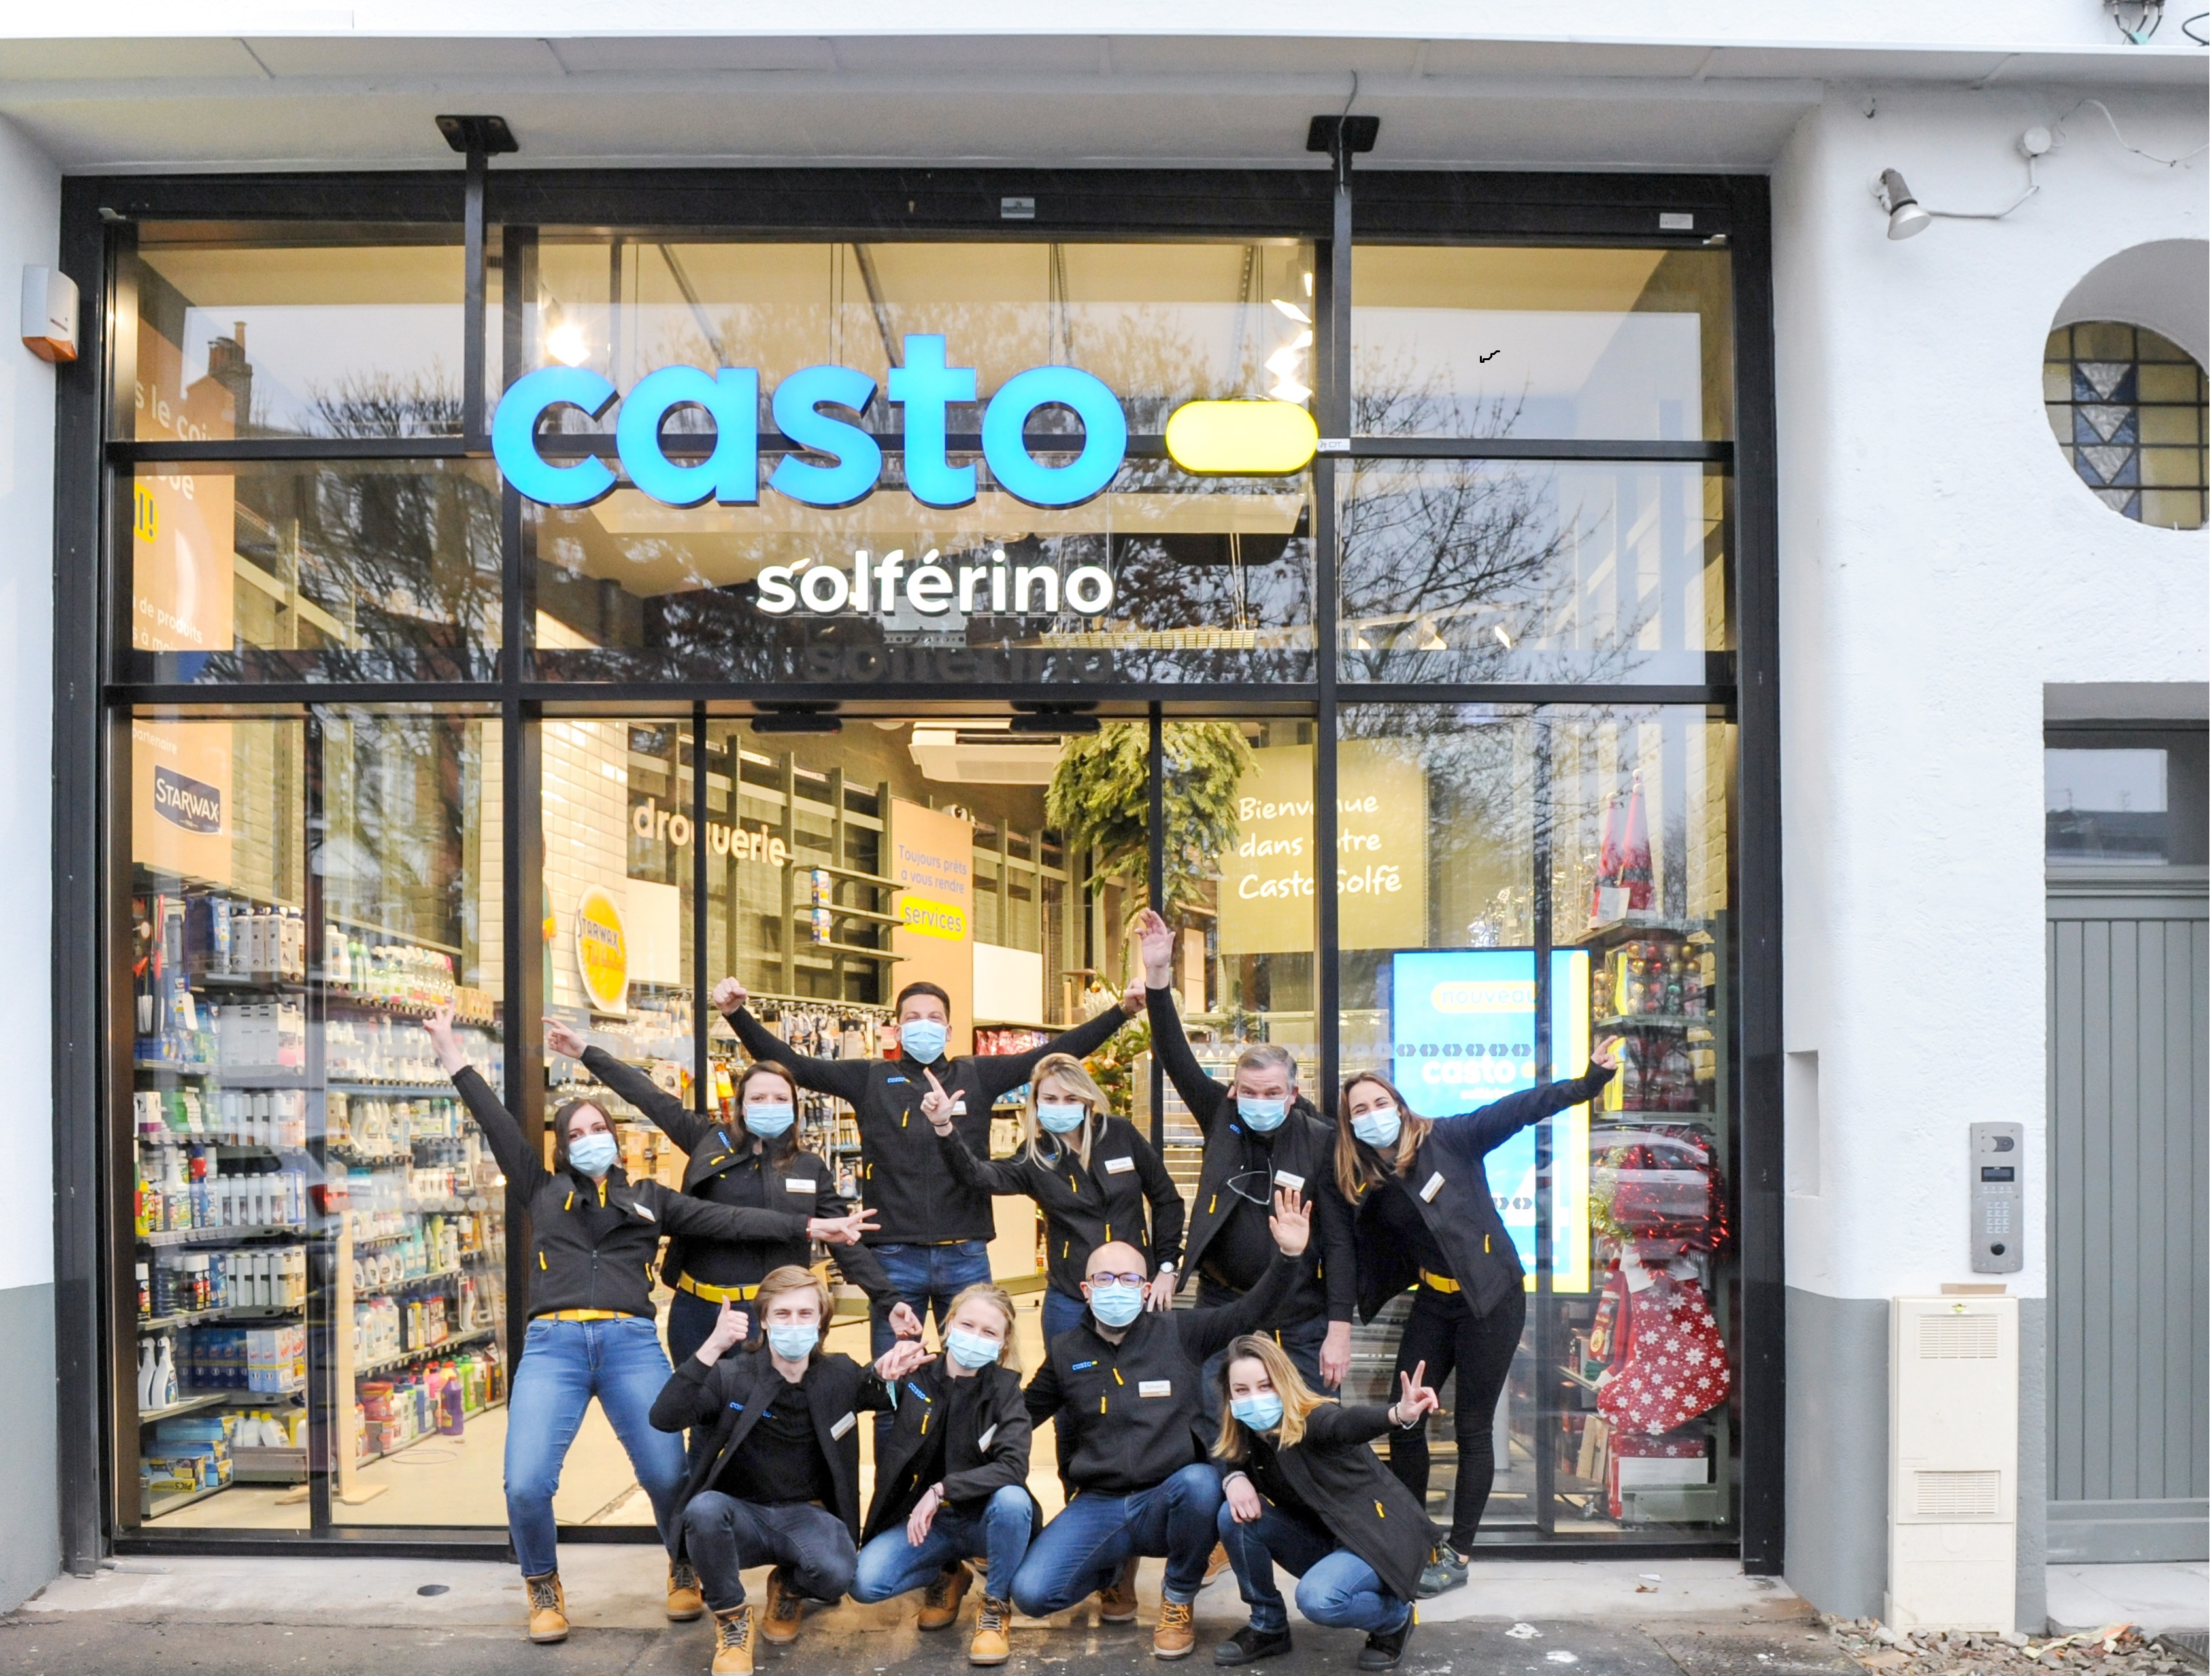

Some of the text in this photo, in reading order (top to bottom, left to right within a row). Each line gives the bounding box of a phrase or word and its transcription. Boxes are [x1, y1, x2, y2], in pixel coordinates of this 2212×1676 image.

[152, 384, 171, 428] le
[492, 334, 1128, 508] casto
[756, 548, 1114, 616] solférino
[139, 597, 203, 645] de produits
[133, 726, 177, 754] partenaire
[156, 777, 220, 823] STARWAX
[1239, 796, 1379, 821] Bienvue
[633, 797, 786, 867] drouerie
[1239, 833, 1303, 858] dans
[899, 844, 941, 869] Toujours
[901, 866, 965, 895] à vous rendre
[1239, 871, 1314, 899] Casto
[578, 909, 620, 955] STARWAX
[905, 905, 963, 933] services
[1442, 989, 1537, 1005] nouveau
[1422, 1054, 1516, 1084] casto
